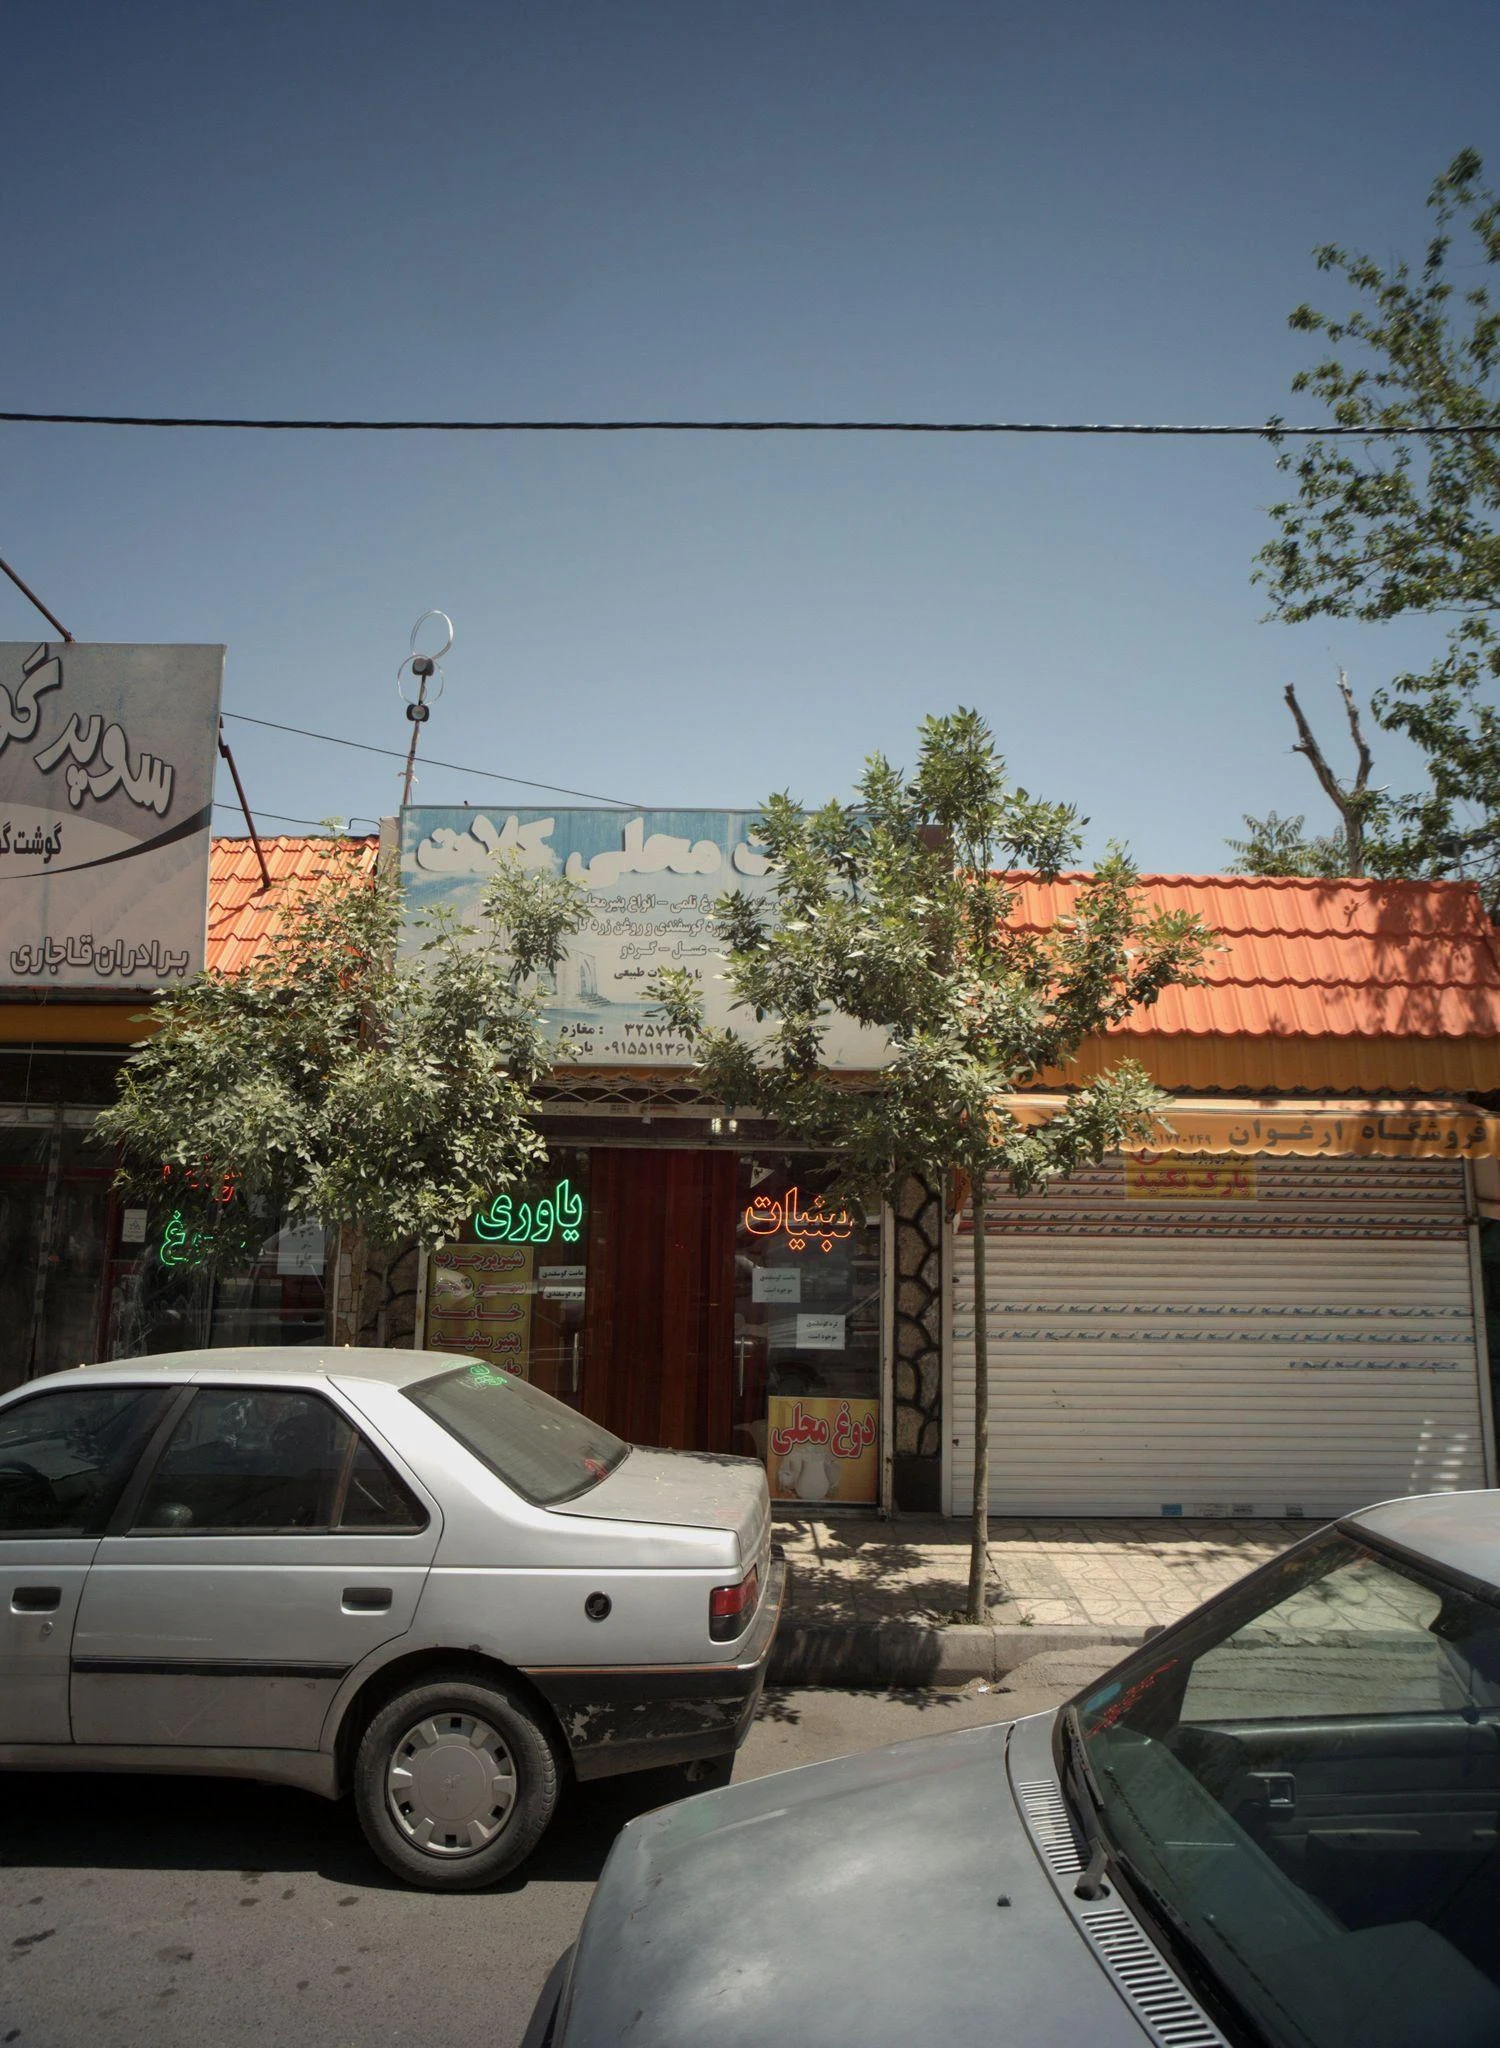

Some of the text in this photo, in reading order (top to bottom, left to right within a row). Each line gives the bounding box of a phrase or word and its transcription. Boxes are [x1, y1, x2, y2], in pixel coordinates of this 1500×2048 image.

[34, 712, 173, 816] سوپر
[14, 821, 62, 864] گوشت
[566, 816, 721, 890] محلی
[627, 894, 656, 914] انواع
[591, 919, 613, 935] زرد
[614, 917, 644, 936] روغن
[646, 922, 653, 936] و
[654, 917, 704, 937] گوسفندی
[10, 935, 189, 977] برادران قاجاری
[620, 940, 707, 959] عسل گردو
[614, 967, 645, 980] طبیعی
[1229, 1118, 1343, 1147] ارغوان
[1362, 1117, 1488, 1149] فروشگاه
[1134, 1169, 1188, 1195] نکنید
[1195, 1168, 1249, 1198] پارک
[475, 1178, 583, 1243] یاوری
[431, 1302, 525, 1321] خامه
[430, 1329, 522, 1353] پنیر سفید
[771, 1400, 876, 1458] دوغ محلی
